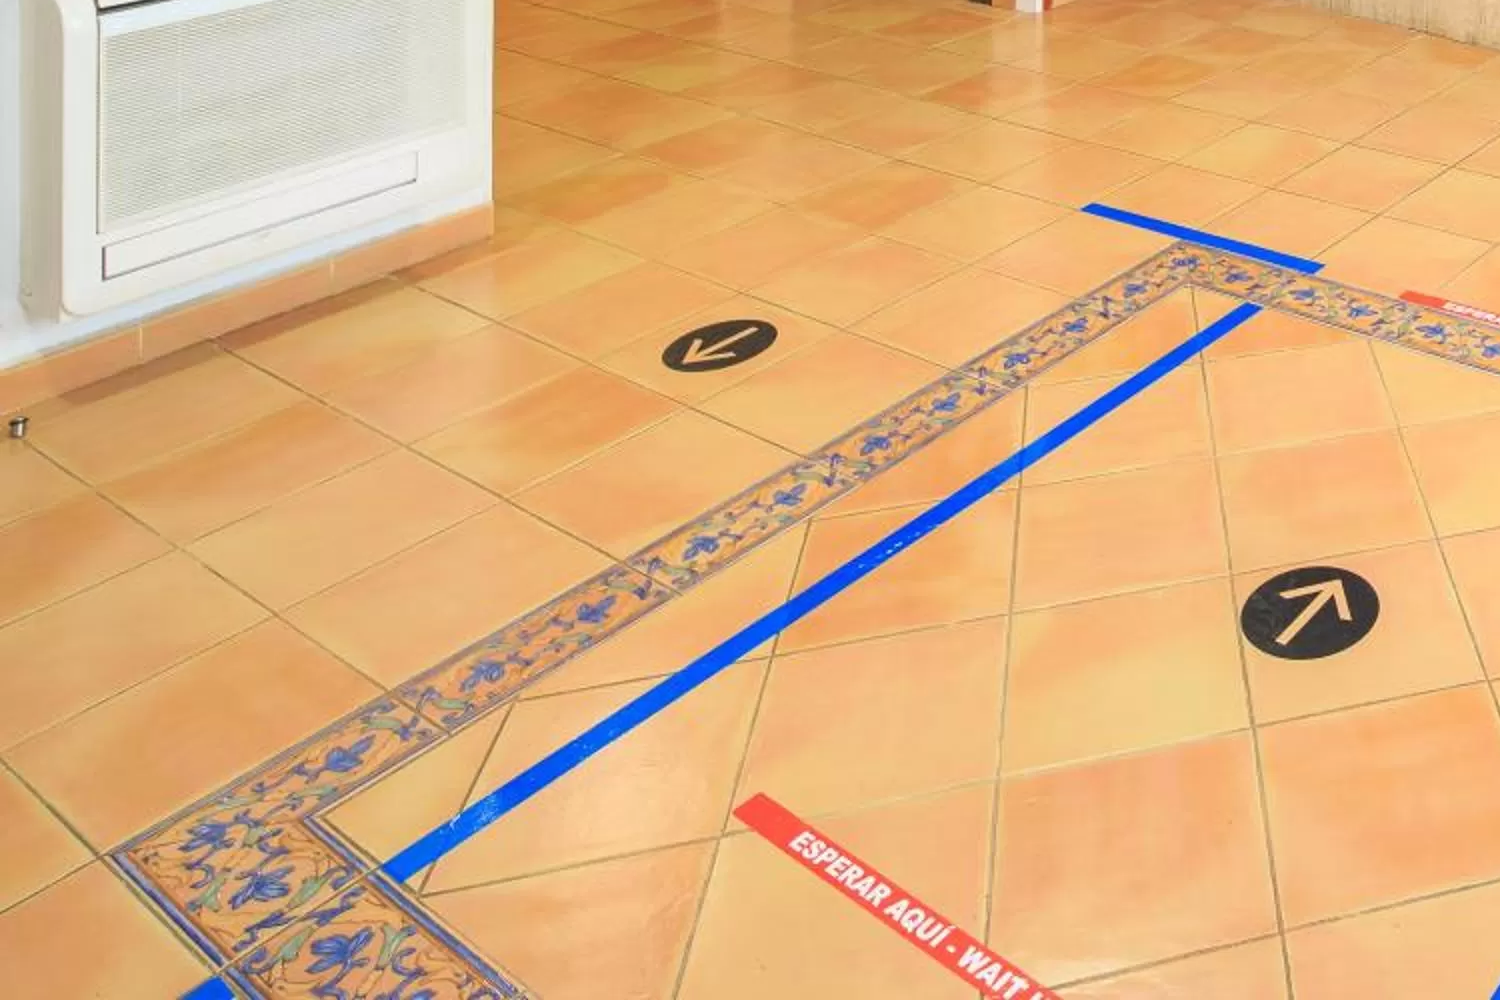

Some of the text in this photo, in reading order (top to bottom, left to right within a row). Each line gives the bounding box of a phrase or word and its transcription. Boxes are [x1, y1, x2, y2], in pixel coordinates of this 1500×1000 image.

[788, 831, 892, 908] ESPERAR
[883, 898, 956, 948] AQUÍ
[957, 945, 1030, 1000] WAIT
